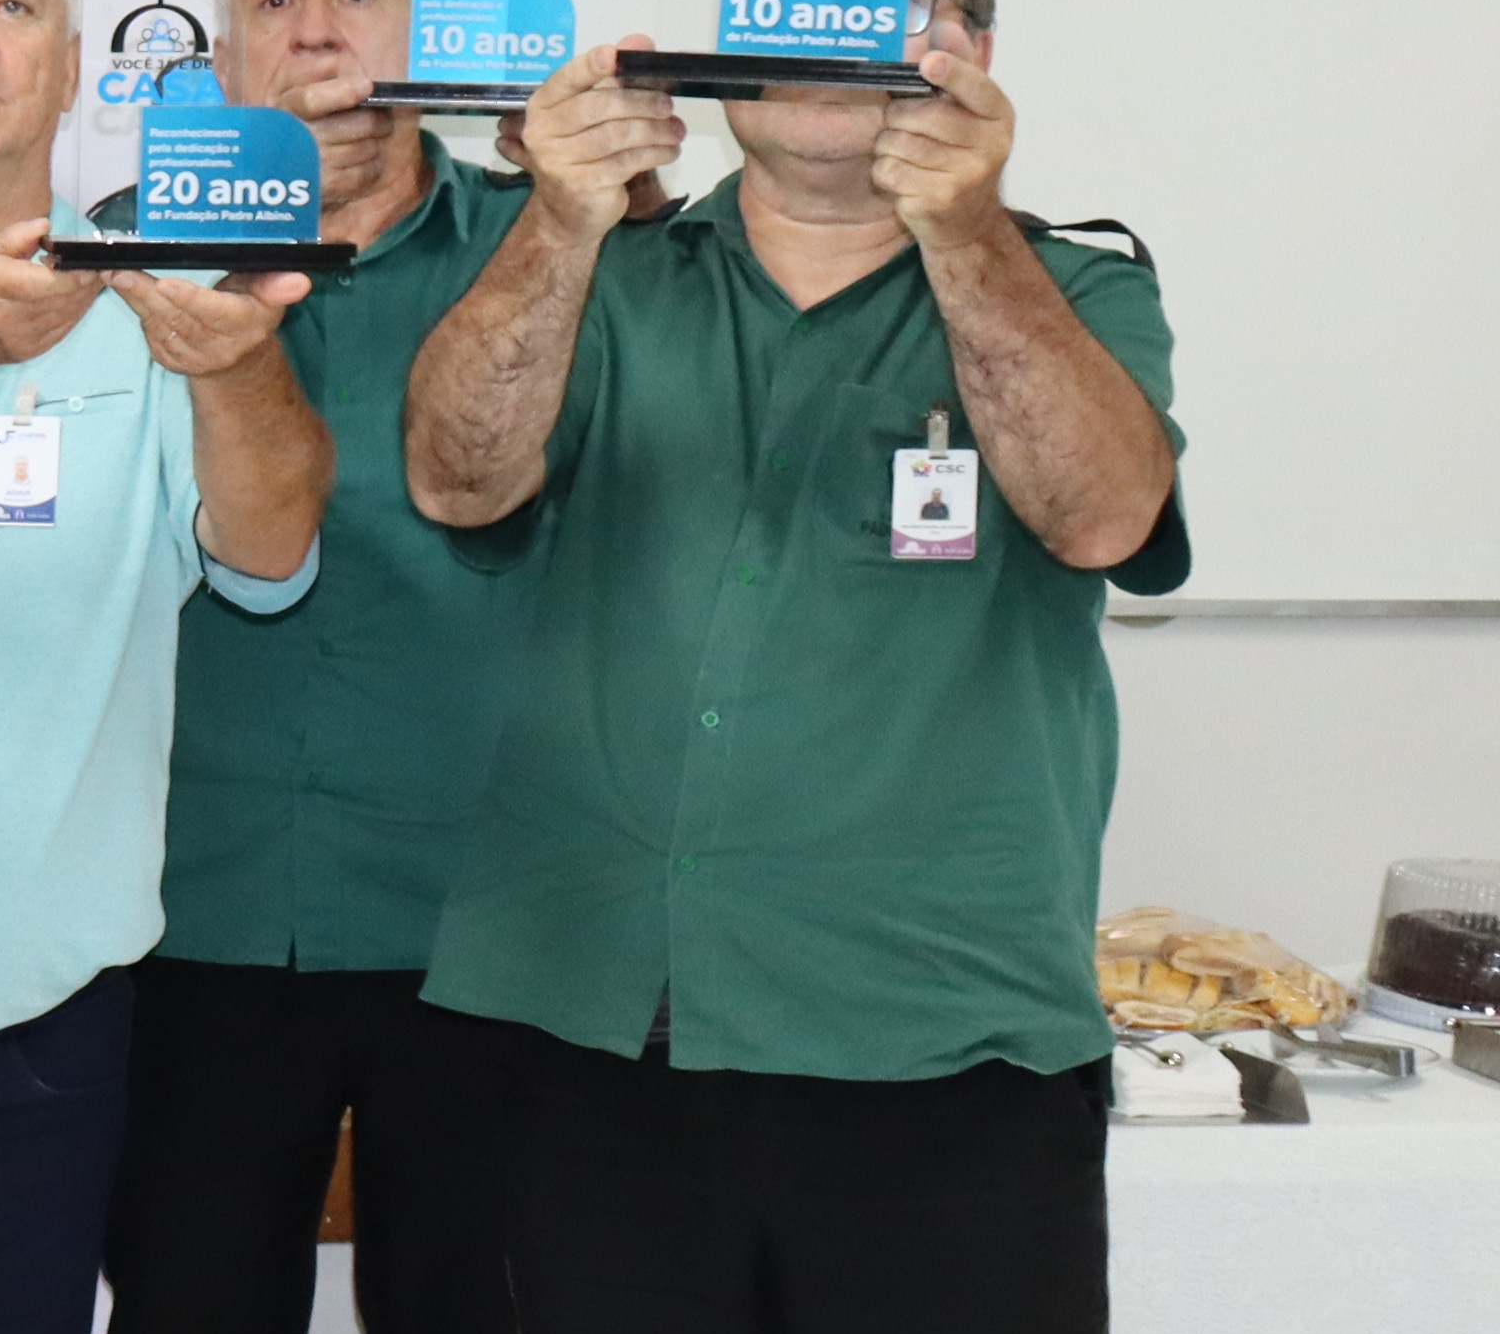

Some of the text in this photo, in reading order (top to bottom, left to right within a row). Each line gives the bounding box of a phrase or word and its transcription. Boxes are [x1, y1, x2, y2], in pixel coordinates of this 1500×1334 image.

[789, 2, 897, 33] anos
[419, 24, 566, 58] 10 anos
[97, 71, 227, 105] CASA
[147, 171, 310, 206] 20 anos
